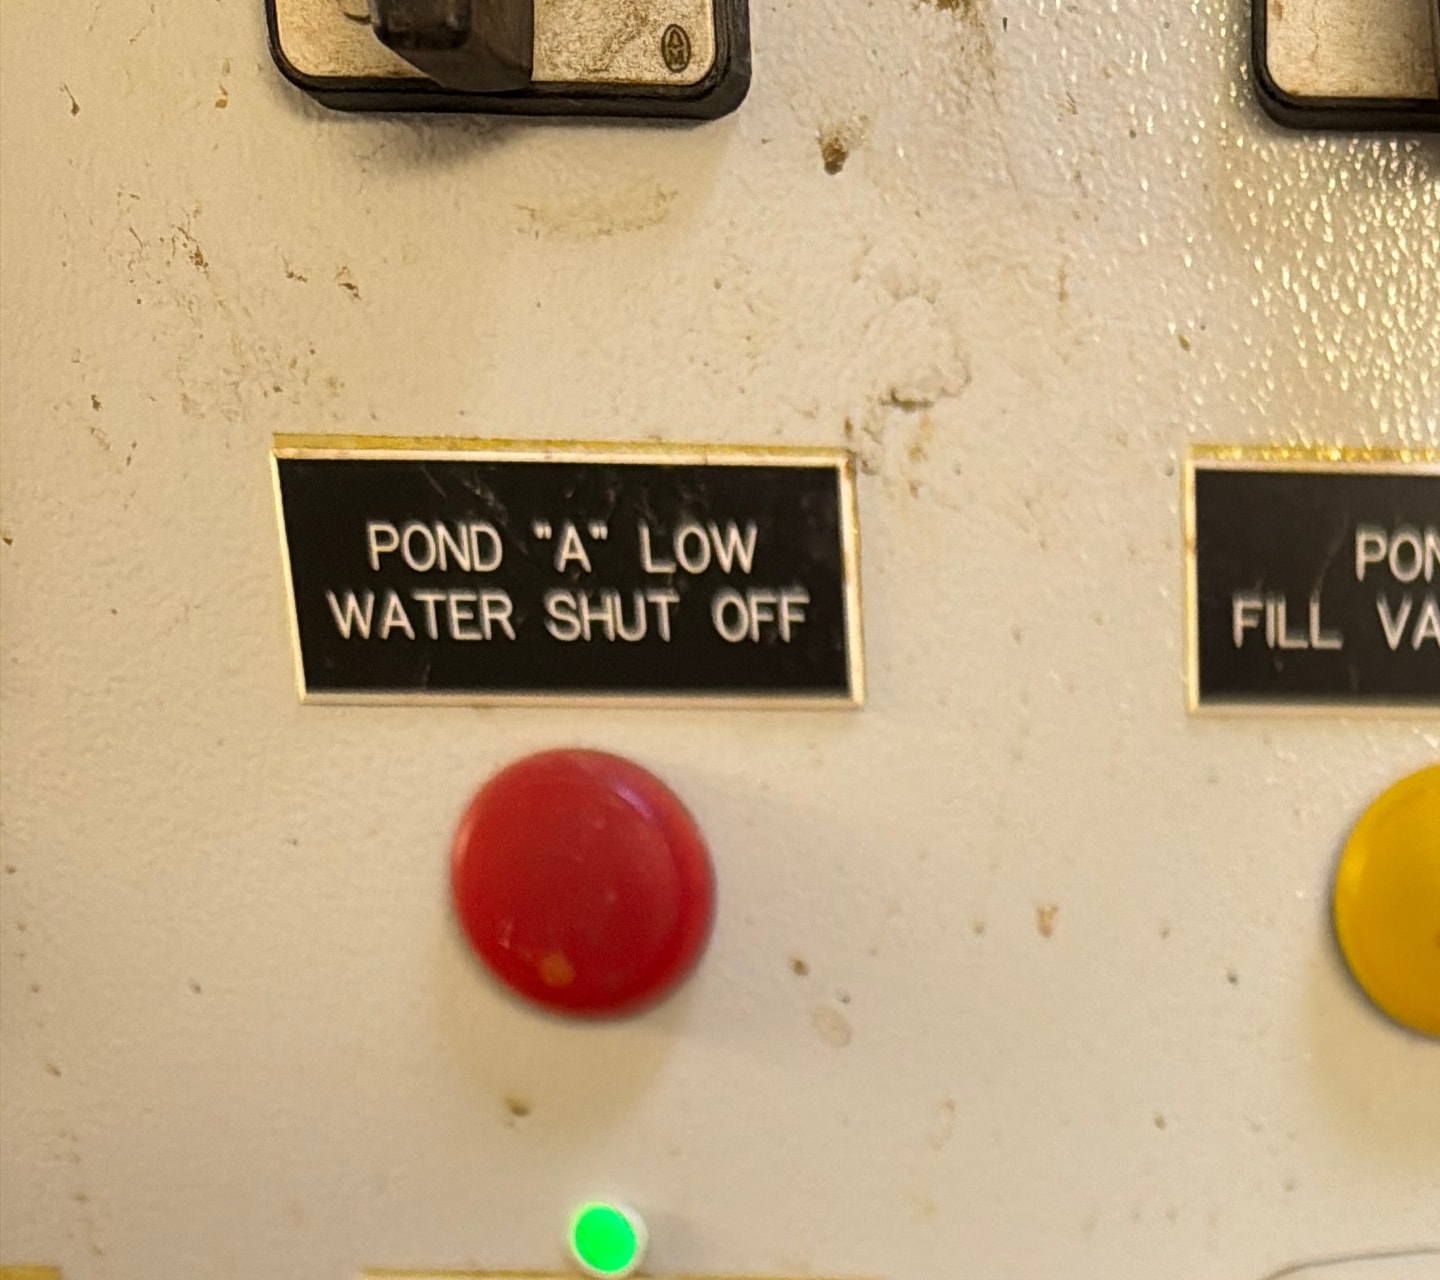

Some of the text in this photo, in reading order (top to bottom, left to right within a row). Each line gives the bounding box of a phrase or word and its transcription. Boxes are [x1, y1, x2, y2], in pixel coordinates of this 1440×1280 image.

[367, 519, 758, 575] POND "A" LOW
[326, 586, 811, 644] WATER SHUT OFF
[1231, 594, 1343, 650] FILL
